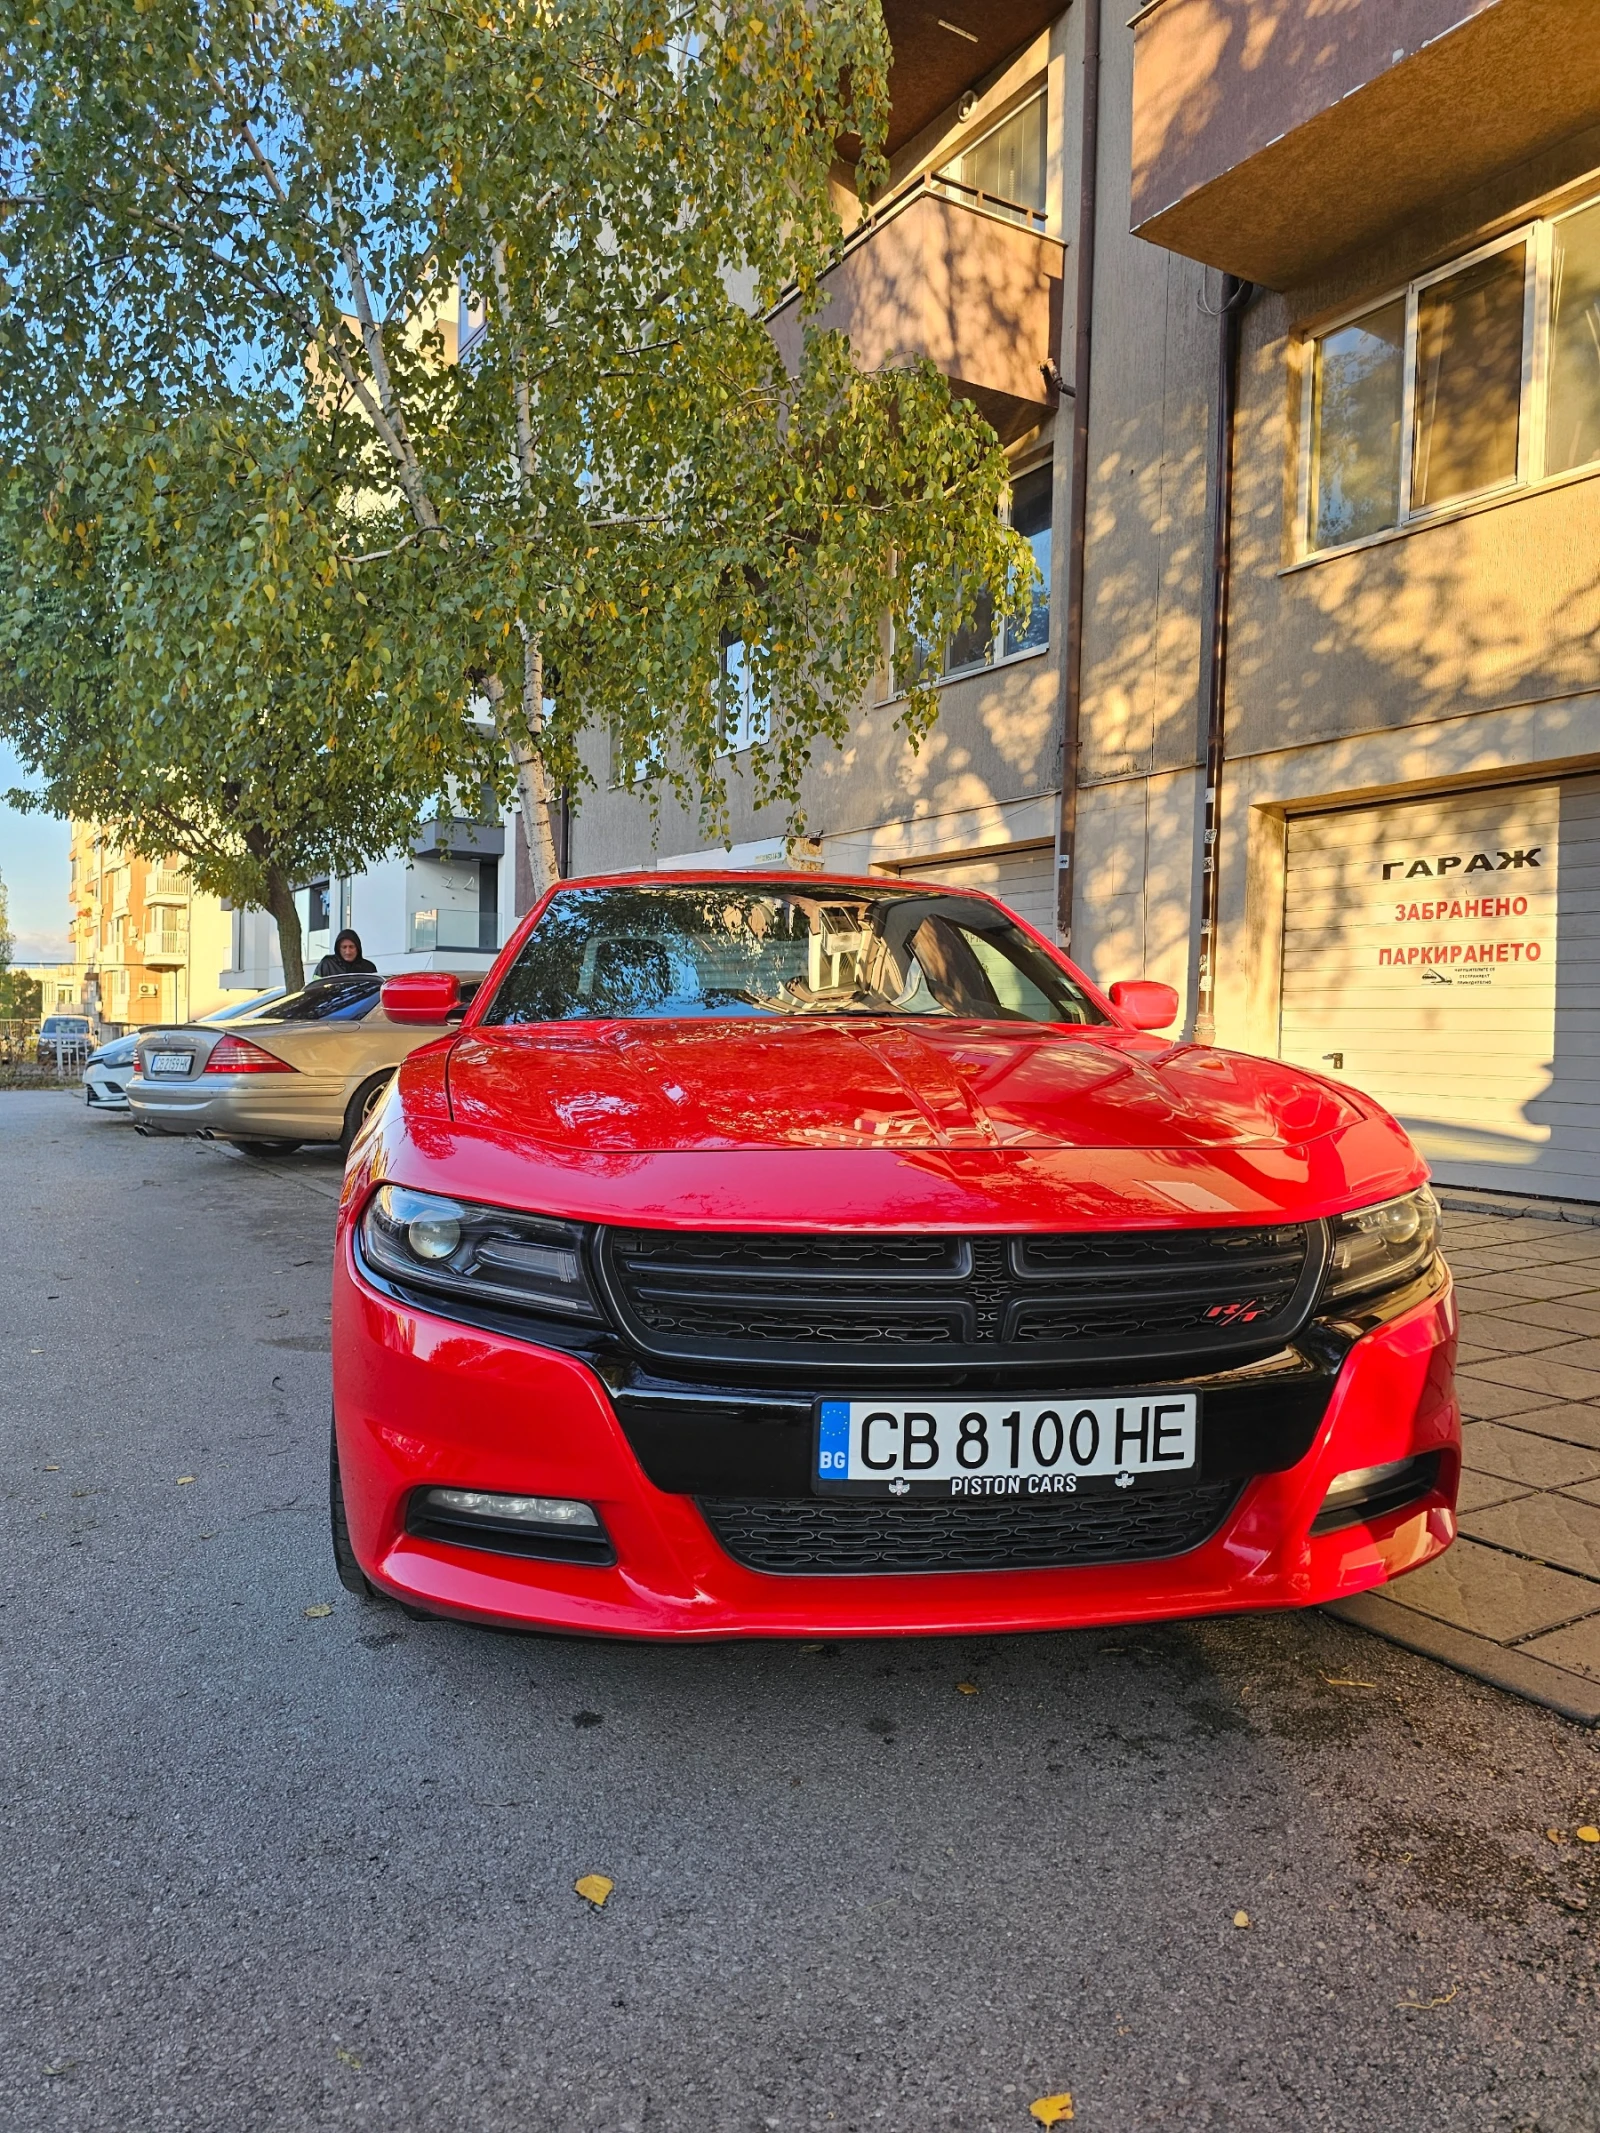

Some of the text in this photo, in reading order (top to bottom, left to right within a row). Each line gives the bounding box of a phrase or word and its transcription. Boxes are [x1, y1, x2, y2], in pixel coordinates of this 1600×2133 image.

[1382, 848, 1541, 880] ГАРАЖ
[1395, 896, 1528, 921] ЗАБРАНЕНО
[1378, 942, 1541, 965] ПАРКИРАНЕТО
[1206, 1300, 1266, 1326] R/T
[819, 1404, 1186, 1471] BG CB 8100 HE
[951, 1475, 1077, 1496] PISTON CARS
